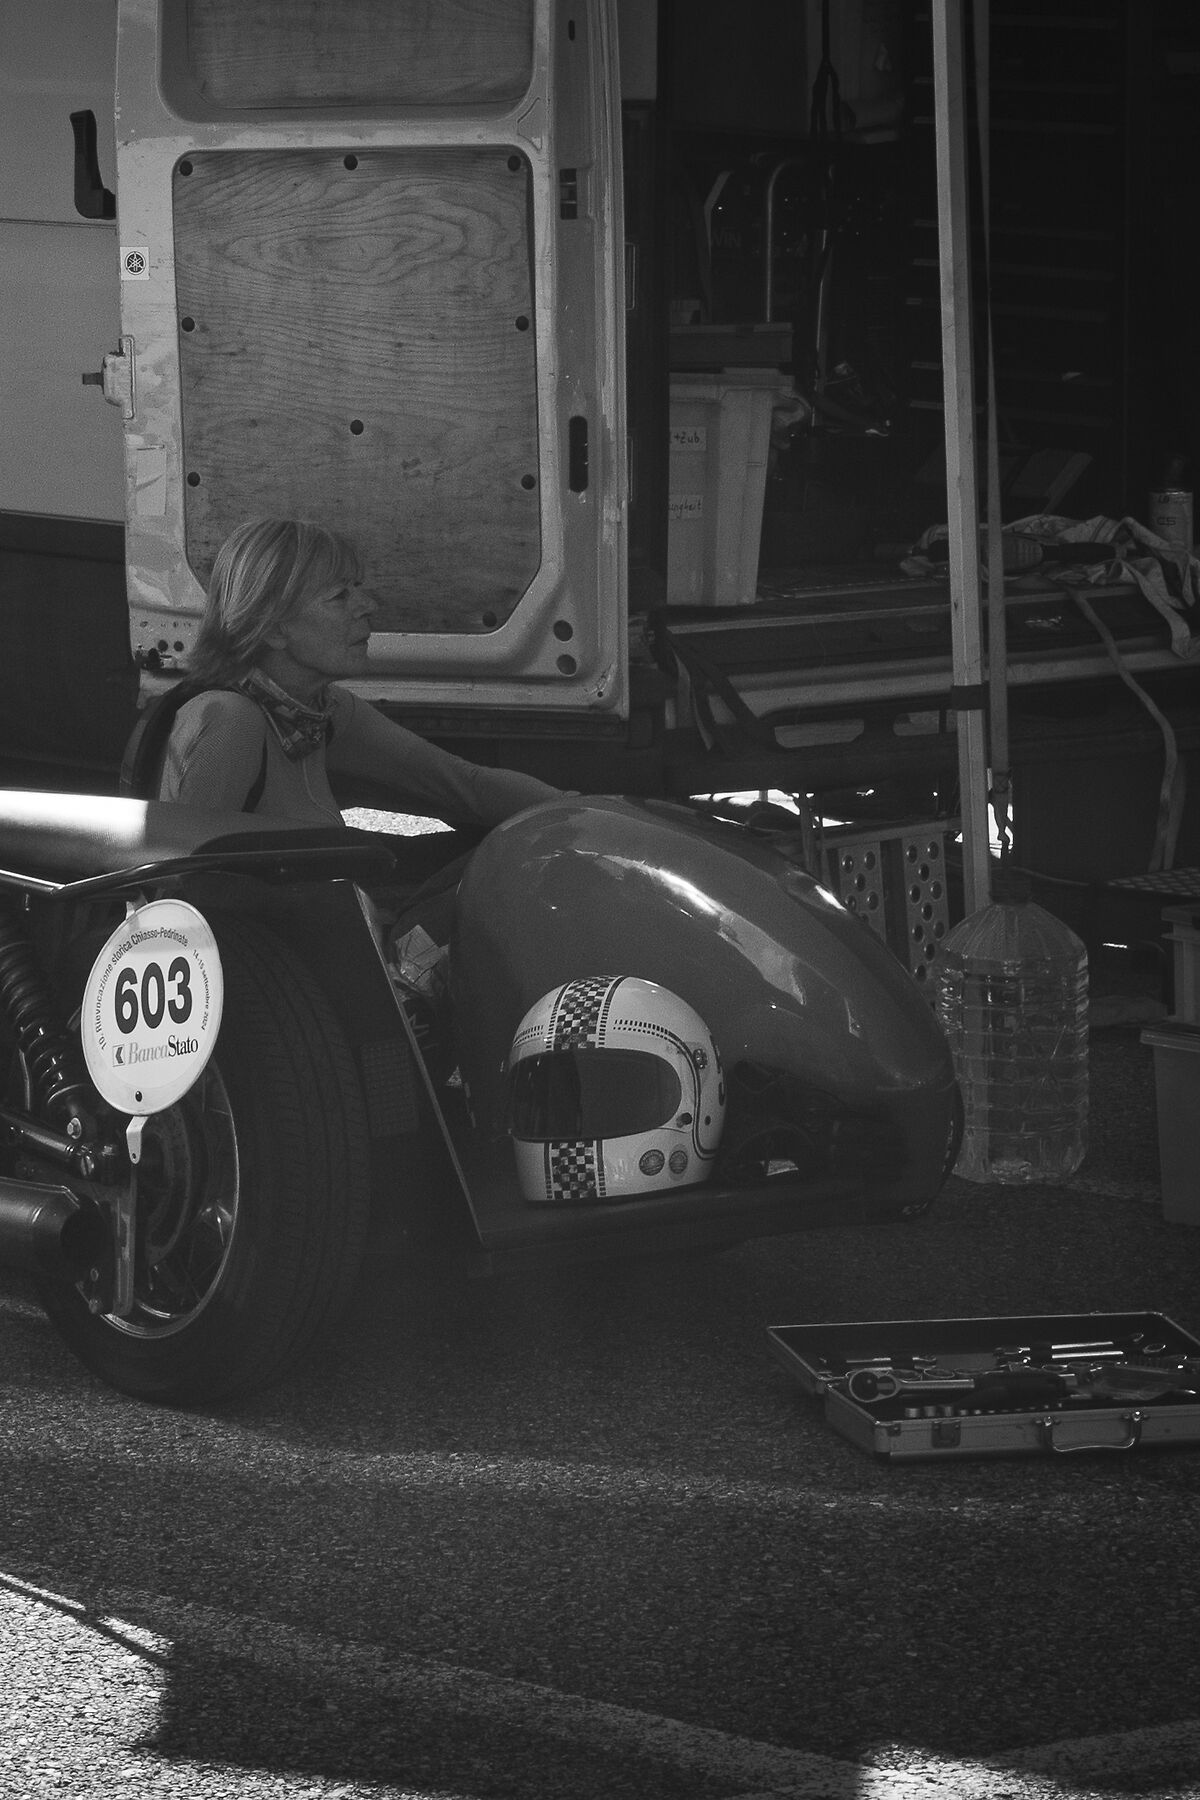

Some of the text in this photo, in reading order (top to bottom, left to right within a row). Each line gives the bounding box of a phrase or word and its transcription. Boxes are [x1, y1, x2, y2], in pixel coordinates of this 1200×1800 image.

[95, 964, 113, 1032] Rievocazione
[111, 940, 133, 965] storica
[131, 927, 188, 947] Chiasso-Pedrinate
[115, 956, 193, 1034] 603
[128, 1034, 199, 1065] BancaStato
